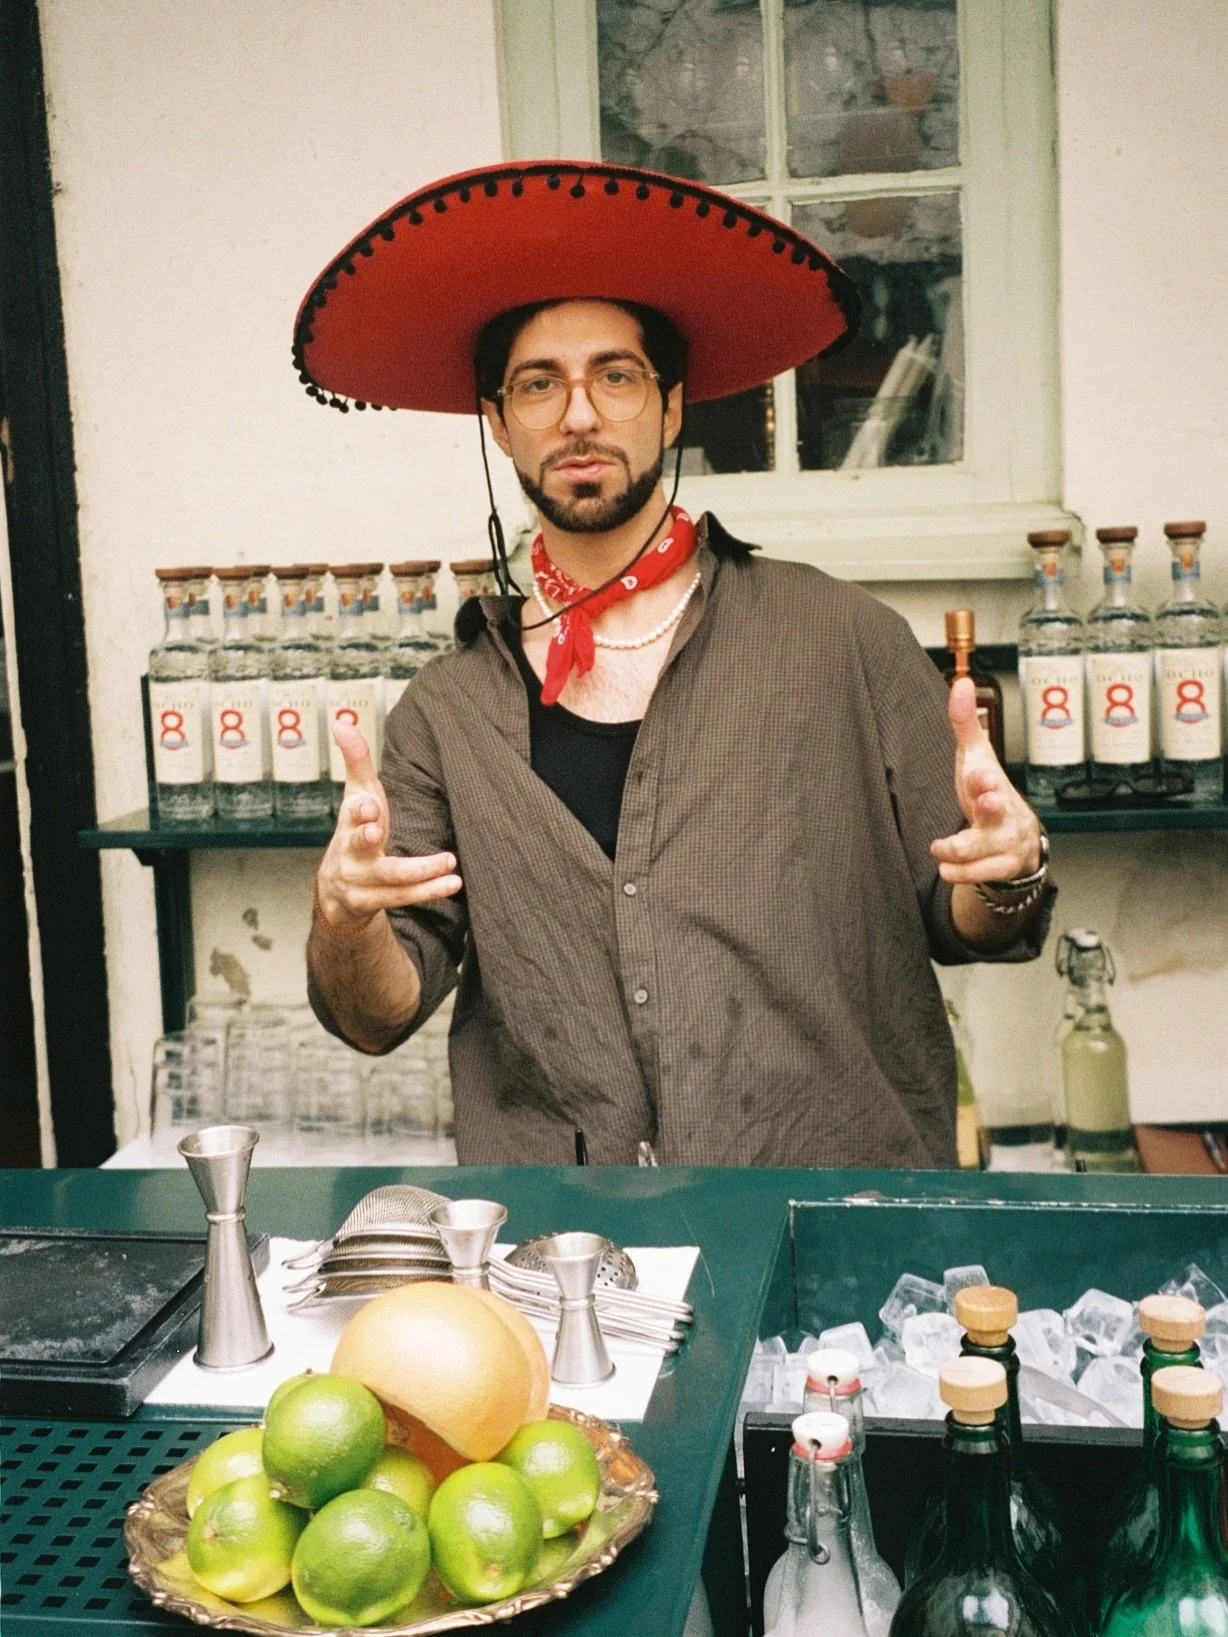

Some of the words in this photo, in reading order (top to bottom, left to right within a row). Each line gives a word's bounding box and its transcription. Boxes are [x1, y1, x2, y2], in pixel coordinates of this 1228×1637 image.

[1041, 685, 1071, 729] 8
[1104, 683, 1136, 727] 8
[1175, 679, 1206, 724] 8
[160, 709, 186, 750] 8
[219, 708, 246, 749] 8
[277, 708, 303, 749] 8
